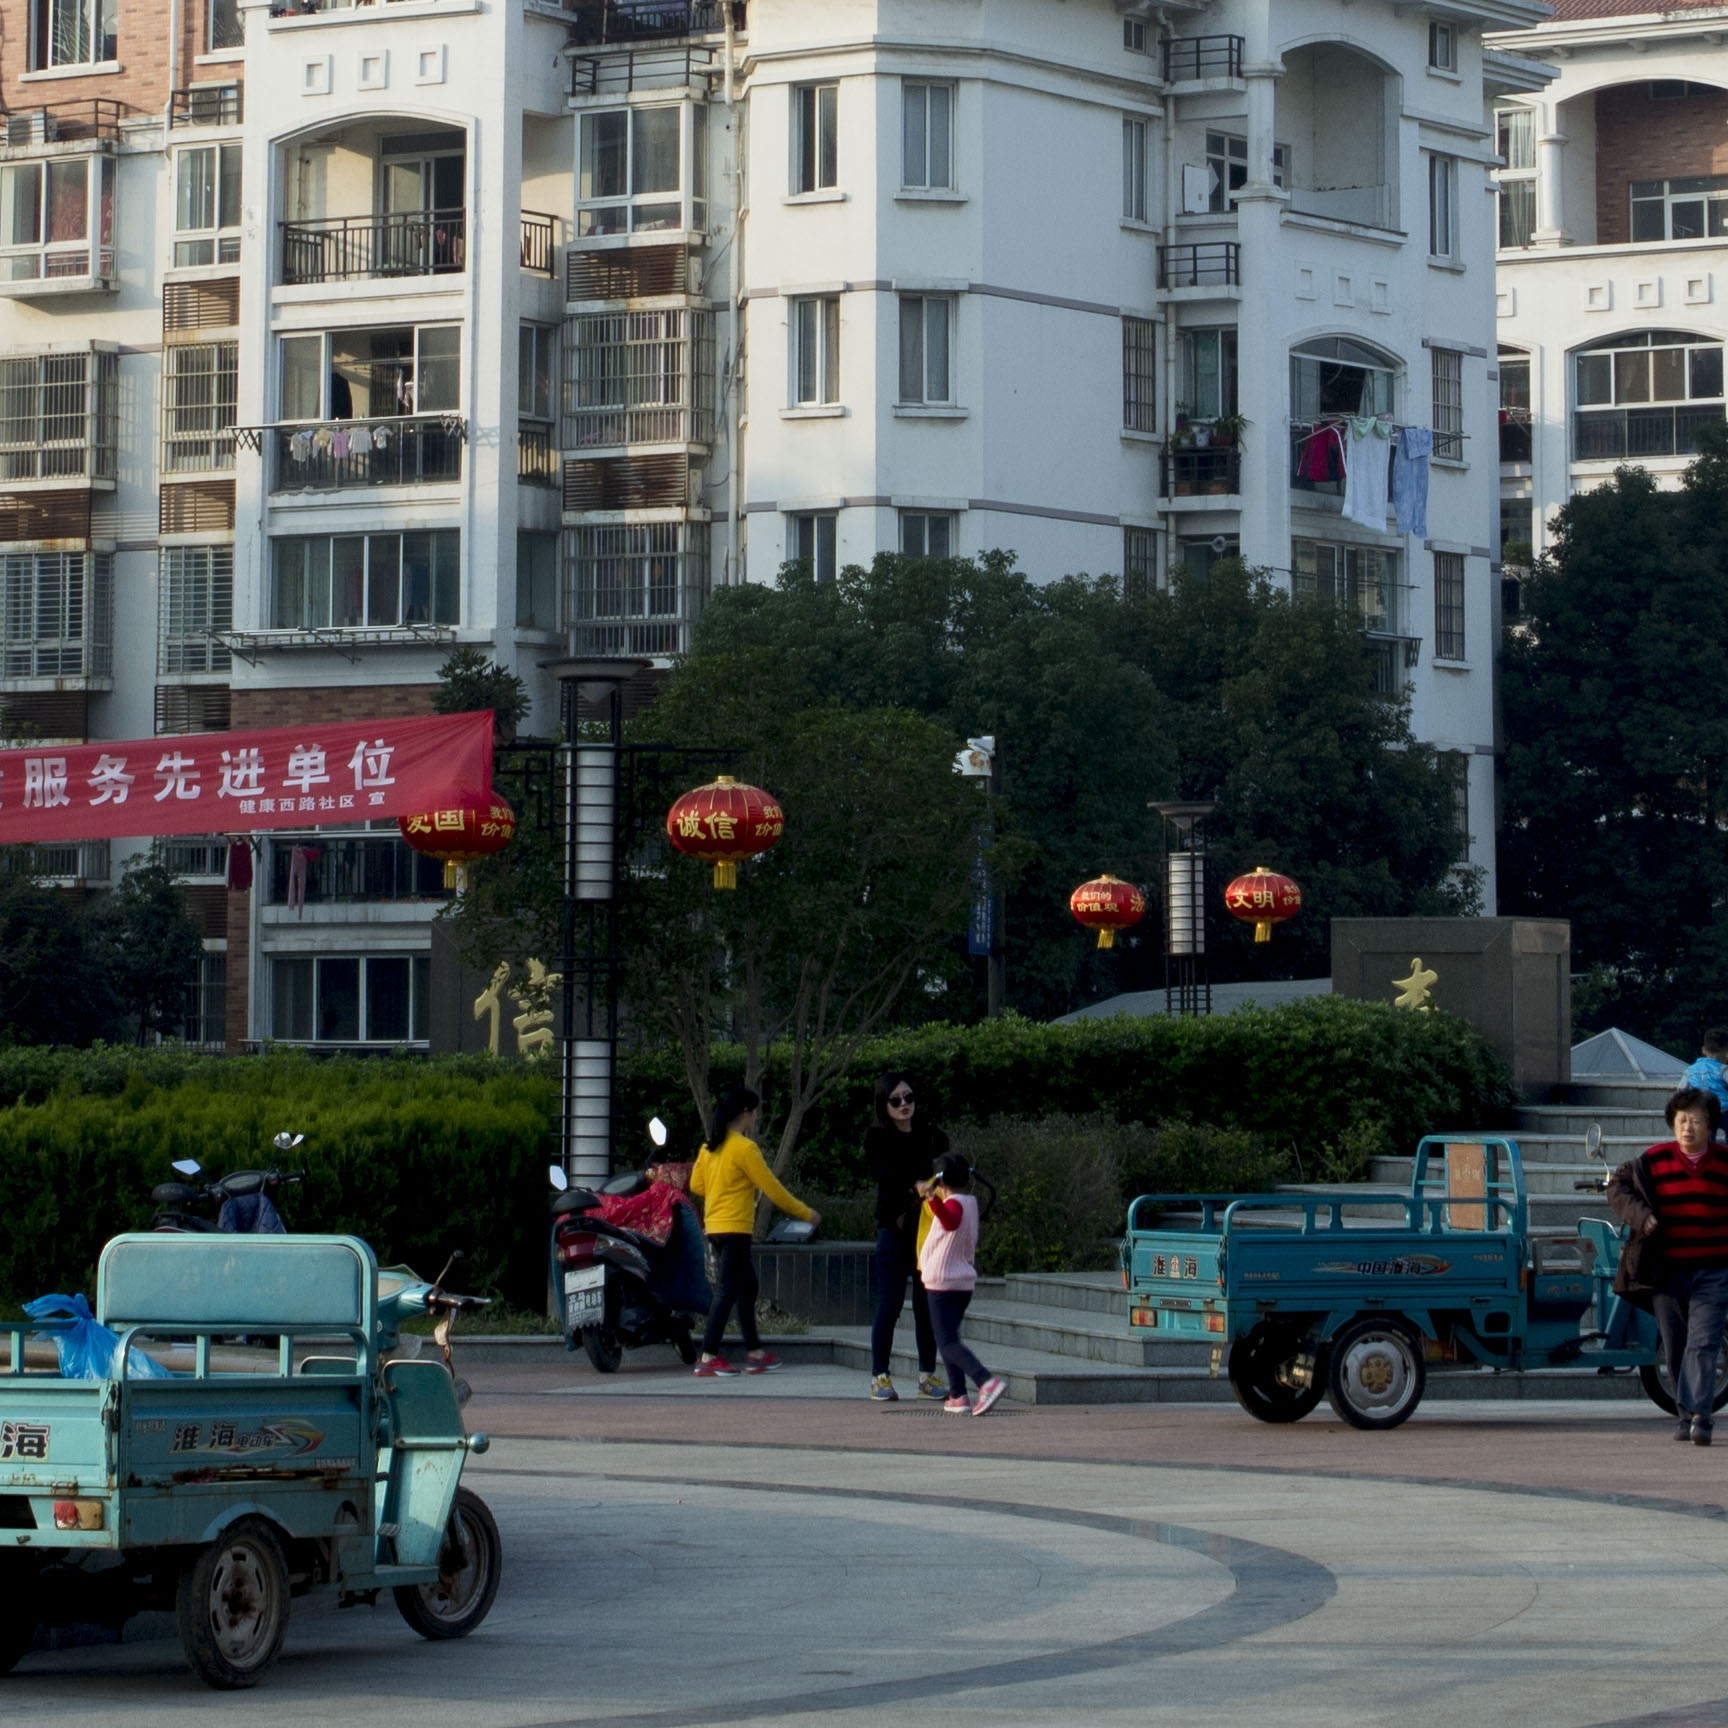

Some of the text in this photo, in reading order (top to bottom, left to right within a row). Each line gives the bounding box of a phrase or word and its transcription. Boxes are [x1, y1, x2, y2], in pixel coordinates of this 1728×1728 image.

[239, 791, 385, 815] 健康西路社区 宣
[677, 810, 739, 840] 诚信
[1076, 902, 1119, 913] 价值观
[1233, 889, 1275, 909] 文明
[1, 1421, 50, 1460] 海
